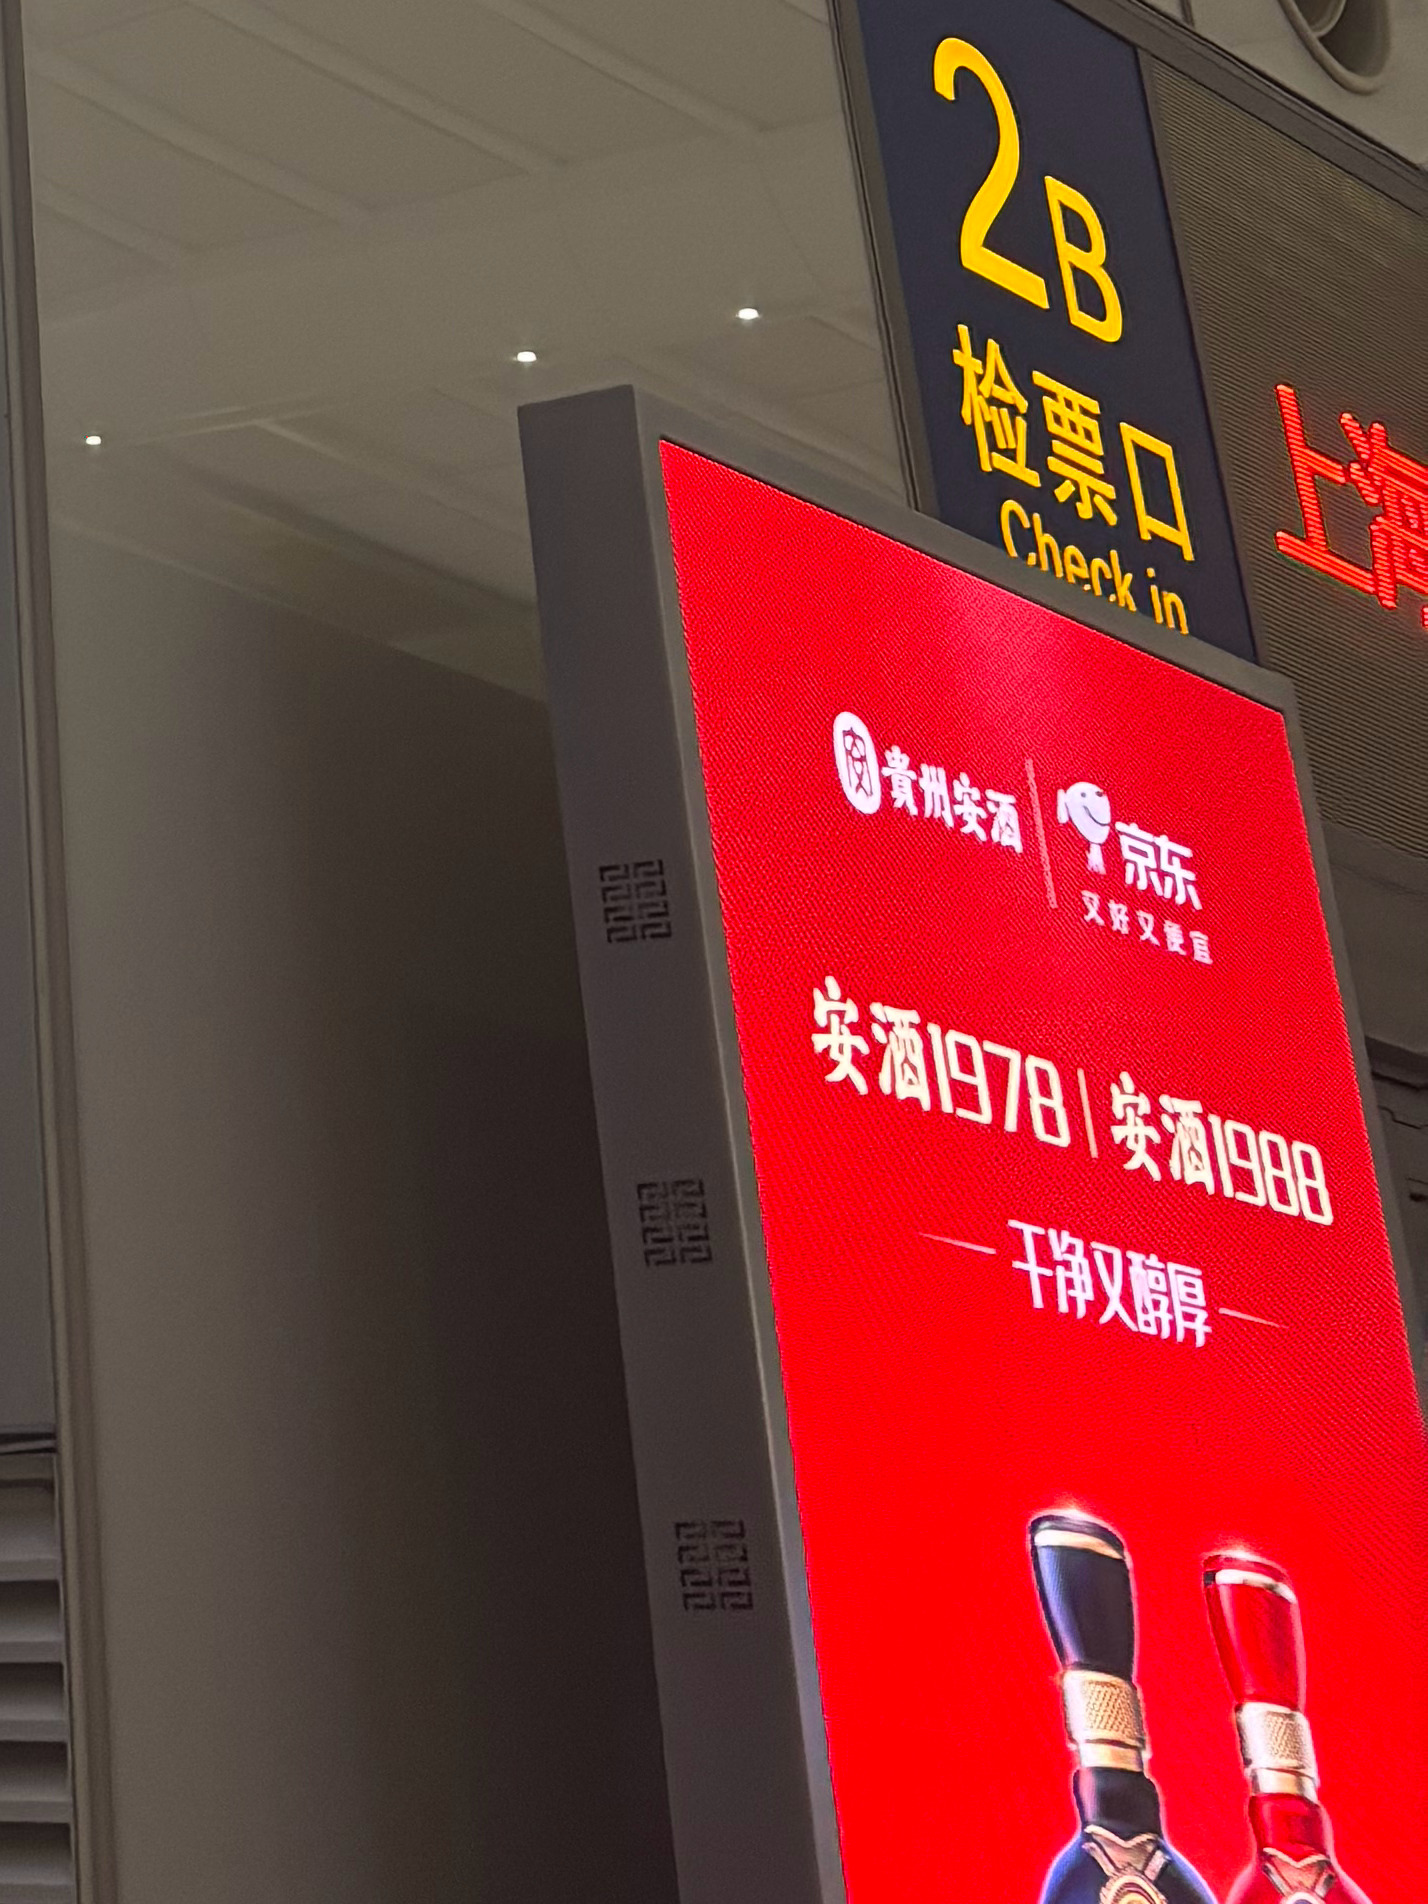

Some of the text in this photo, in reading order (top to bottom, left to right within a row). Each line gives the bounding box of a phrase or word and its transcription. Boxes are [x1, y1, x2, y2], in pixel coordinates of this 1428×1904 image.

[933, 37, 1123, 343] 2B
[953, 324, 1194, 561] 检票口
[1000, 499, 1189, 635] Check in
[1081, 889, 1213, 965] 又好又便宜
[1115, 821, 1202, 911] 京东
[811, 975, 1334, 1226] 安酒1978 安酒1988
[1008, 1219, 1213, 1347] 干净又醇厚
